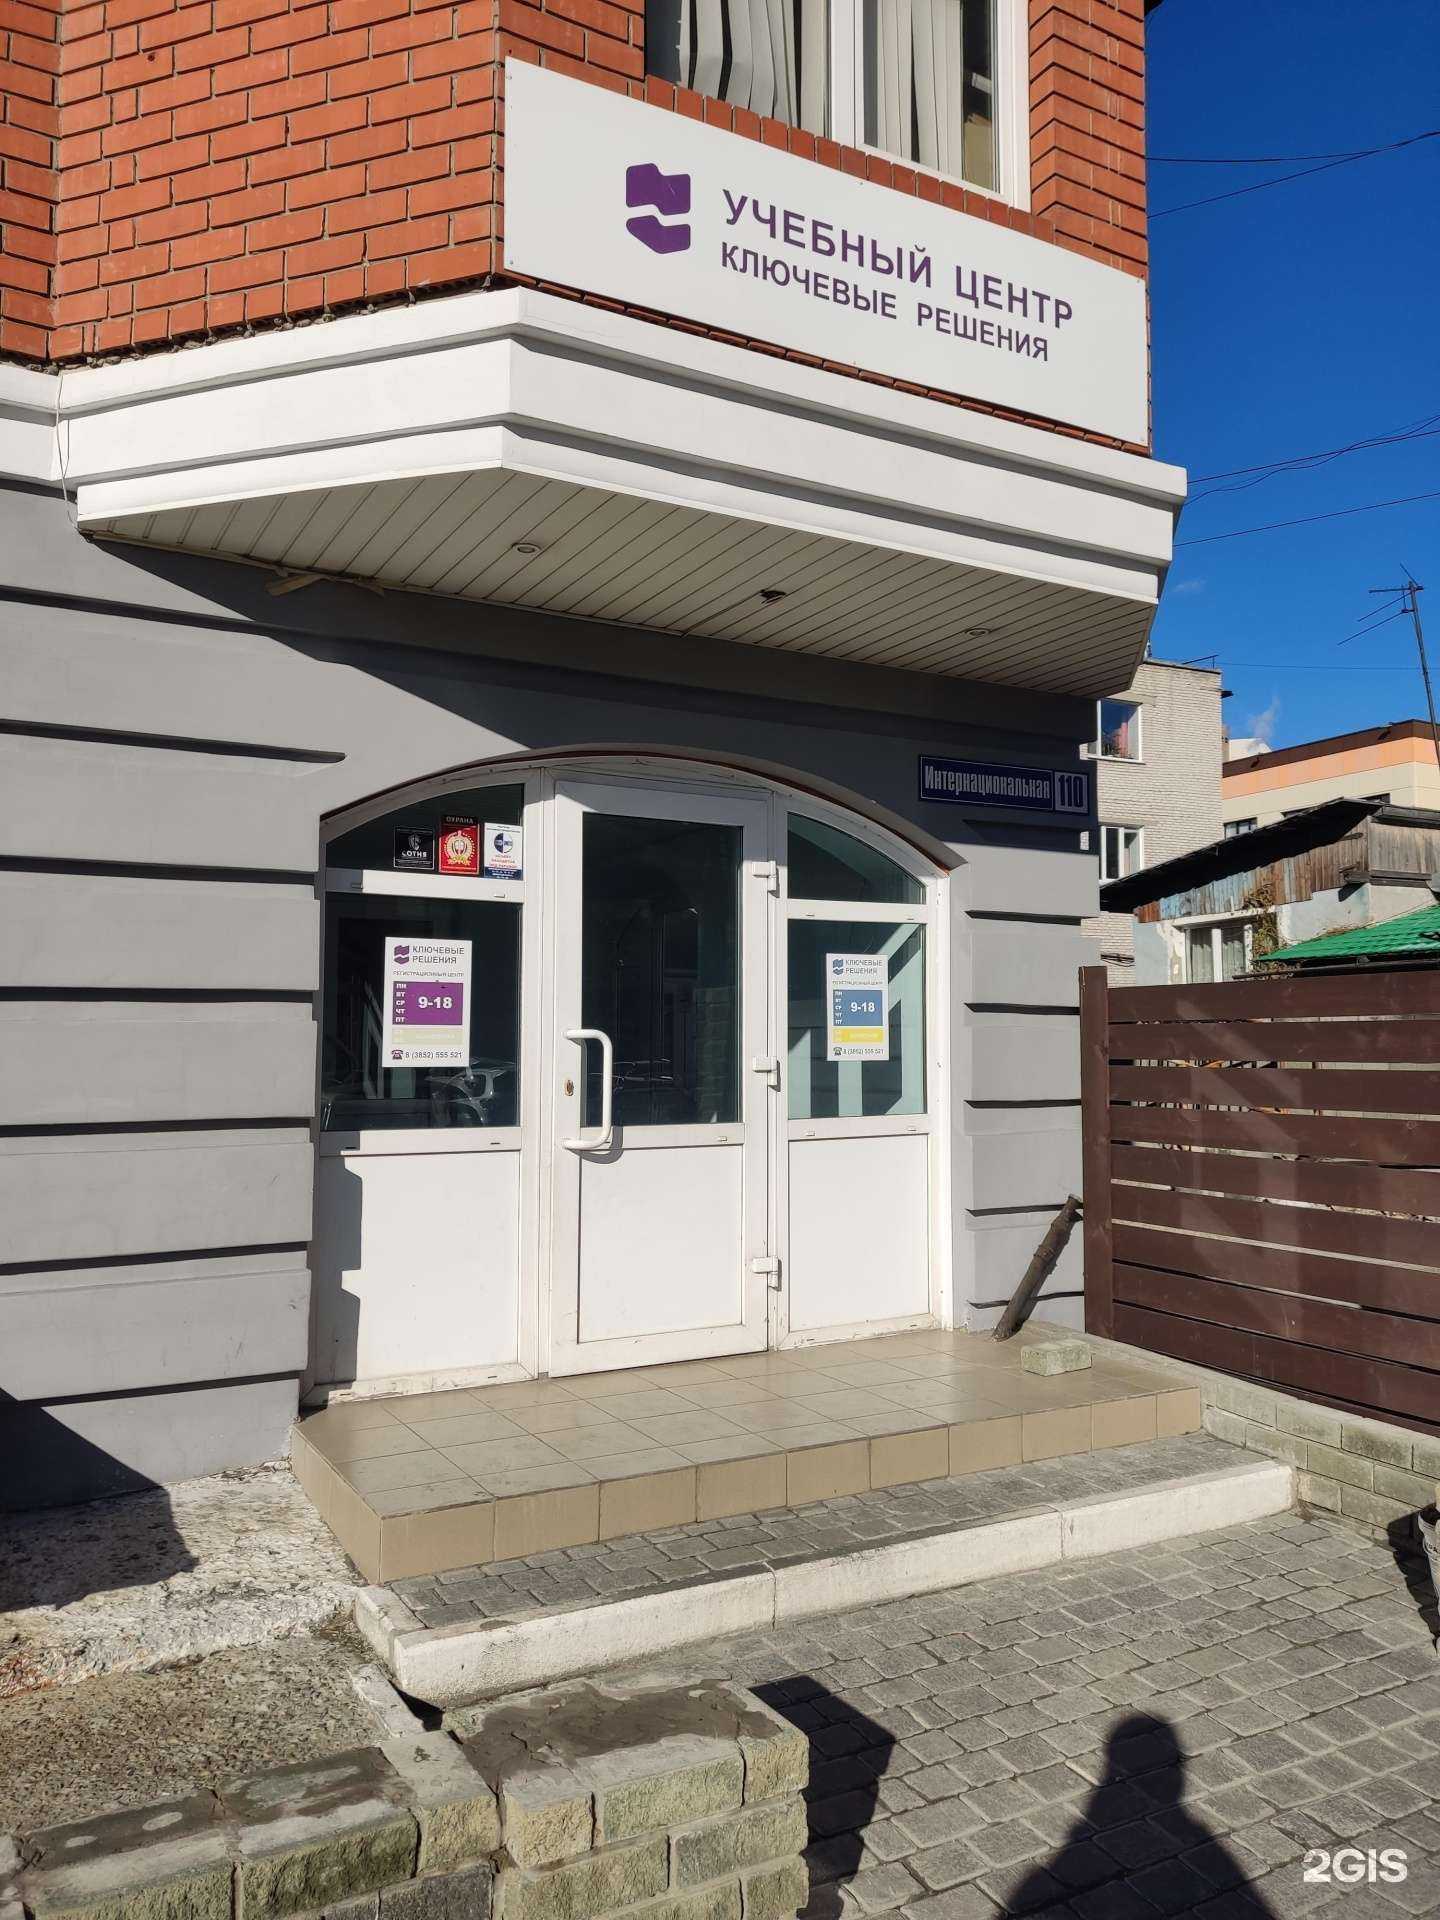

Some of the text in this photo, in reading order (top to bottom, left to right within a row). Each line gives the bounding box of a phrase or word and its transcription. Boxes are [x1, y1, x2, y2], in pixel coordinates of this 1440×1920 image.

[722, 188, 1074, 330] УЧЕБНЫЙ ЦЕНТР
[721, 241, 1049, 362] КЛЮЧЕВЫЕ РЕШЕНИЯ
[924, 765, 1084, 808] Интернациональная 110
[412, 945, 465, 955] КЛЮЧЕВЫЕ
[412, 955, 457, 964] РЕШЕНИЯ
[845, 959, 883, 967] КЛЮЧЕВЫЕ
[417, 996, 453, 1009] 9-18
[850, 1001, 876, 1012] 9-18
[411, 1051, 434, 1059] (3852)
